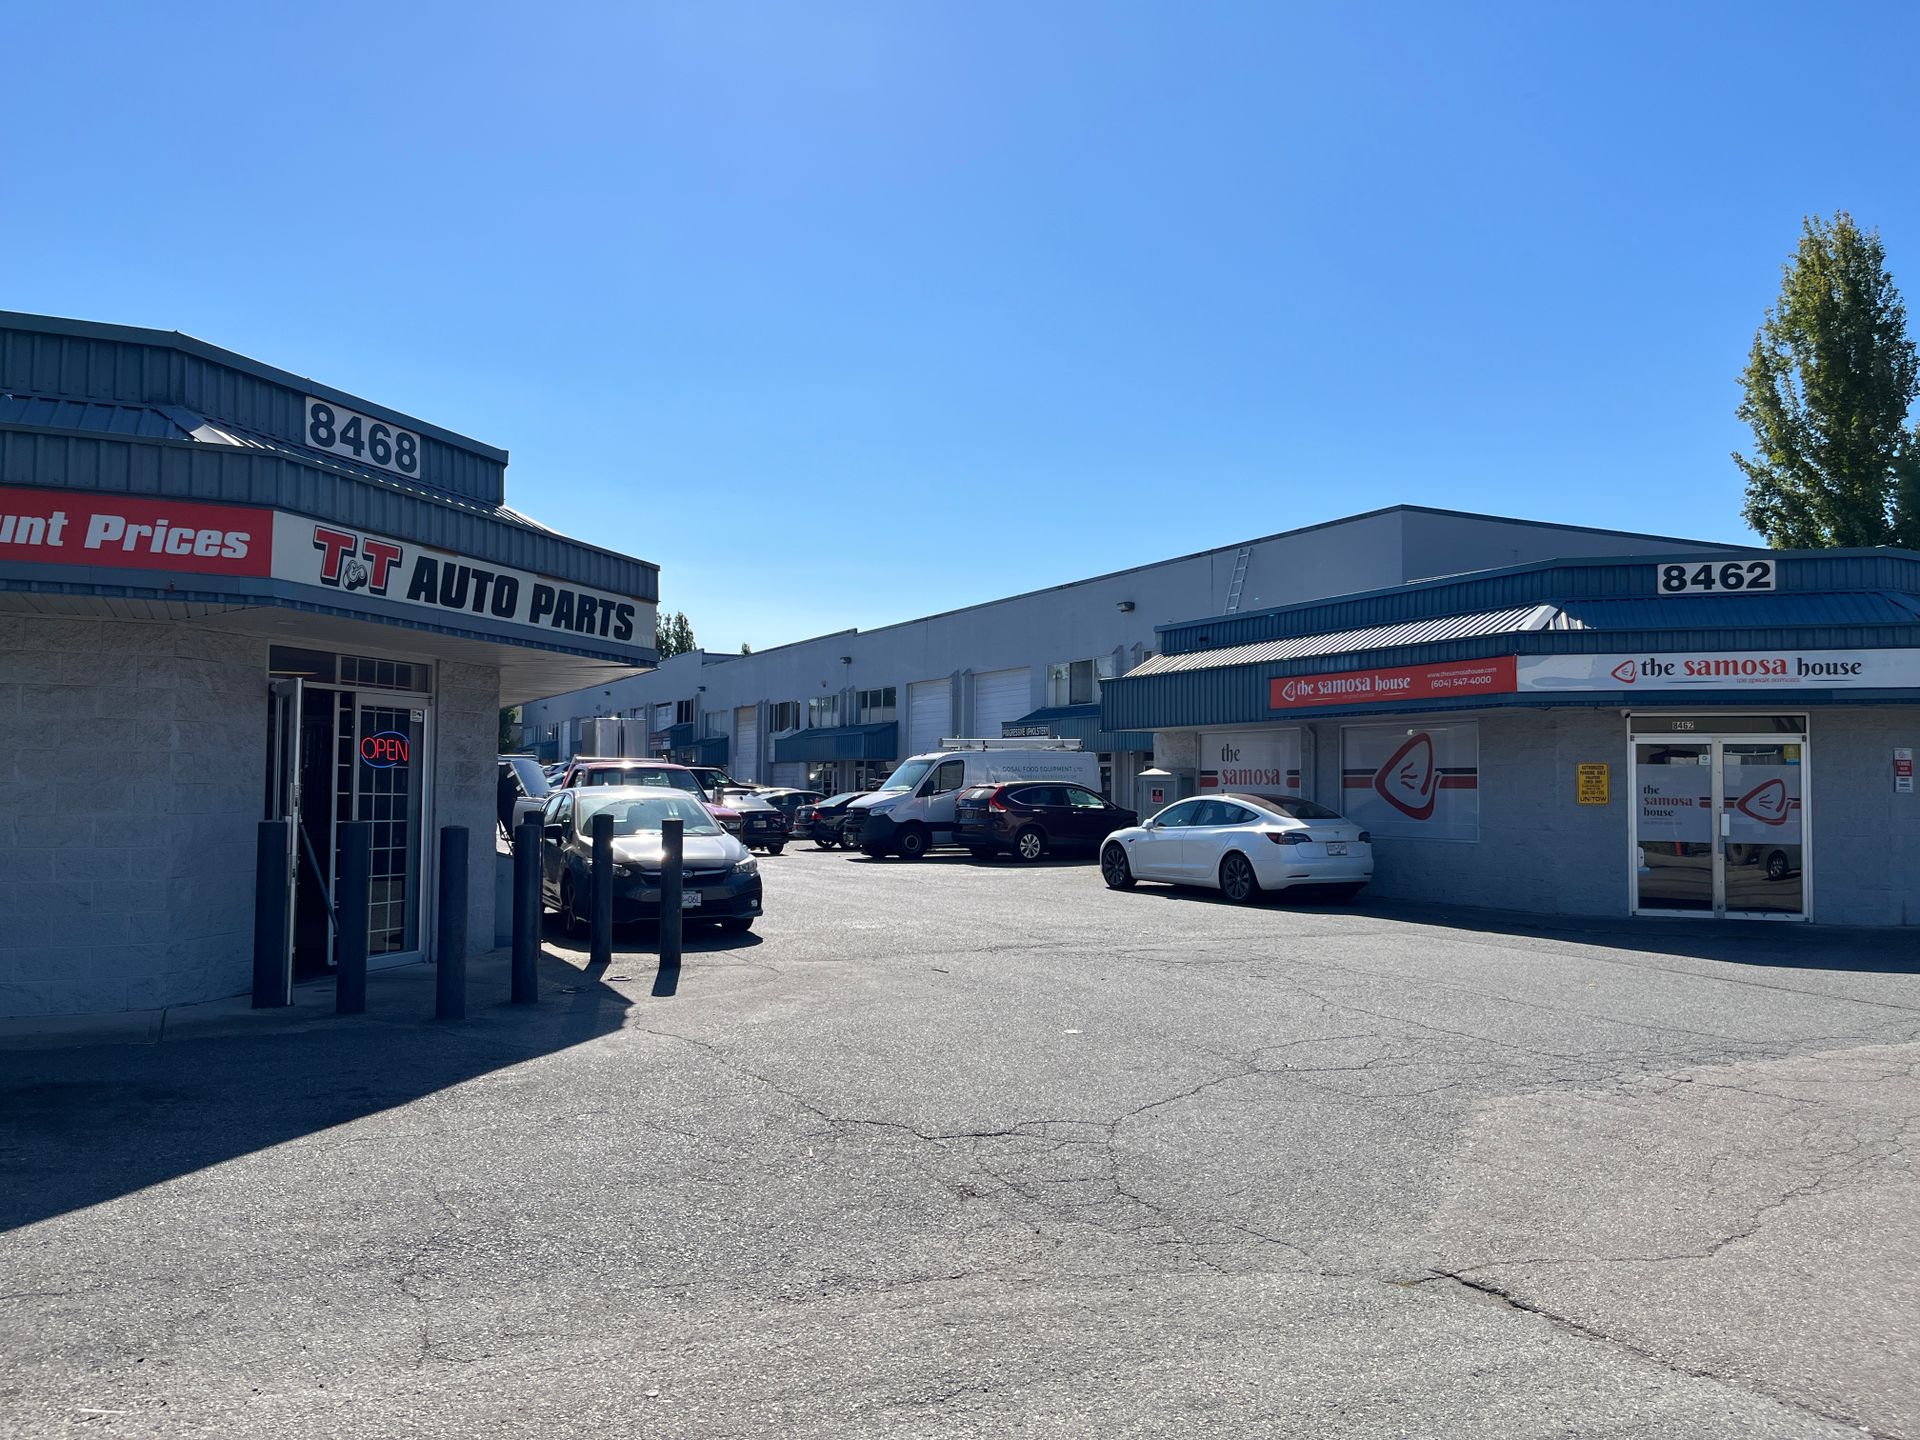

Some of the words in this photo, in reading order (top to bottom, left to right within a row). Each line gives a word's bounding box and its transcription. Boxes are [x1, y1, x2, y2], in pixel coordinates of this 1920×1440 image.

[310, 403, 418, 474] 8468
[84, 513, 251, 559] Prices
[313, 525, 403, 596] T&T
[406, 555, 520, 619] AUTO
[529, 583, 636, 641] PARTS
[1662, 561, 1771, 592] 8462
[1641, 658, 1676, 677] the
[1683, 659, 1787, 676] samosa
[1797, 658, 1863, 677] house
[1297, 677, 1314, 696] the
[1318, 677, 1371, 694] samosa
[1375, 675, 1411, 692] house
[1431, 679, 1451, 689] (604)
[1452, 676, 1492, 687] 547-4000
[361, 737, 409, 762] OPEN
[1221, 743, 1241, 763] the
[1221, 767, 1281, 786] samosa
[1643, 785, 1660, 795] the
[1643, 796, 1693, 806] samosa
[1643, 806, 1674, 817] house
